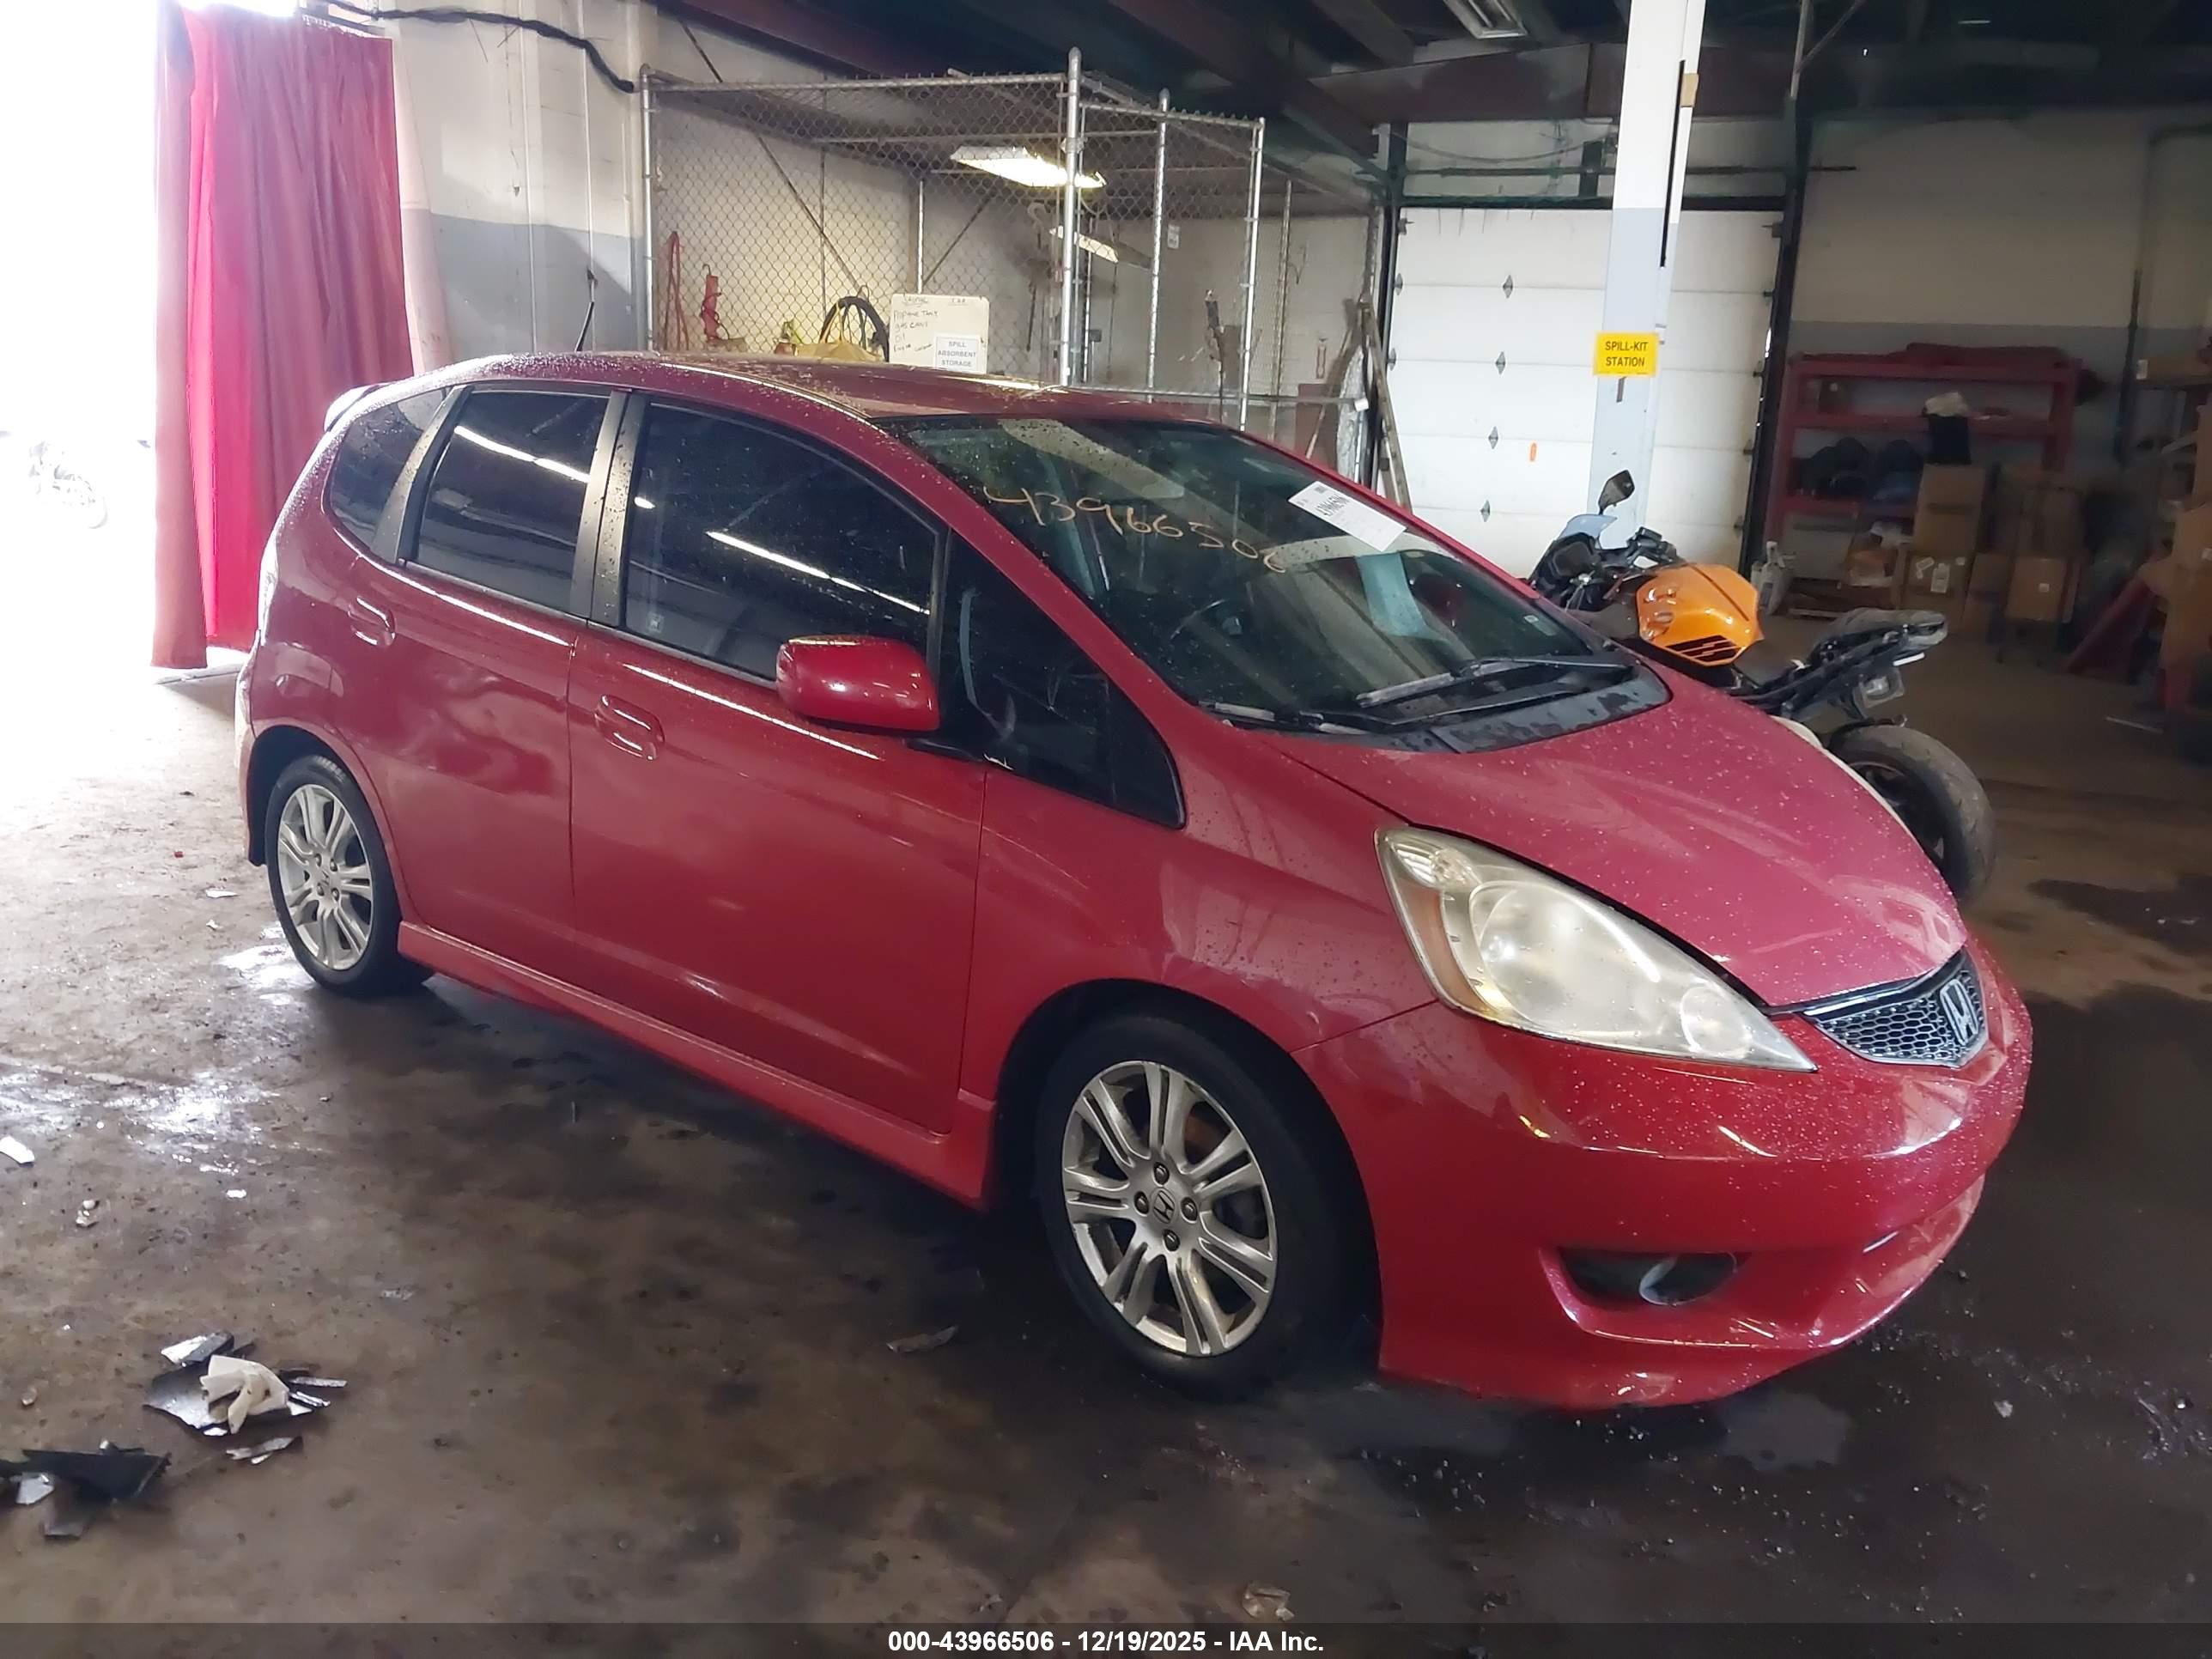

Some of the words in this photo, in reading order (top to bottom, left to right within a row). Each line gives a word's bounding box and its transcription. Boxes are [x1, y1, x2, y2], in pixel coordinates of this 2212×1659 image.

[1604, 340, 1649, 351] SPILL-KIT
[937, 349, 976, 358] ABSORBENT
[941, 359, 972, 368] STORAGE
[1605, 356, 1645, 368] STATION
